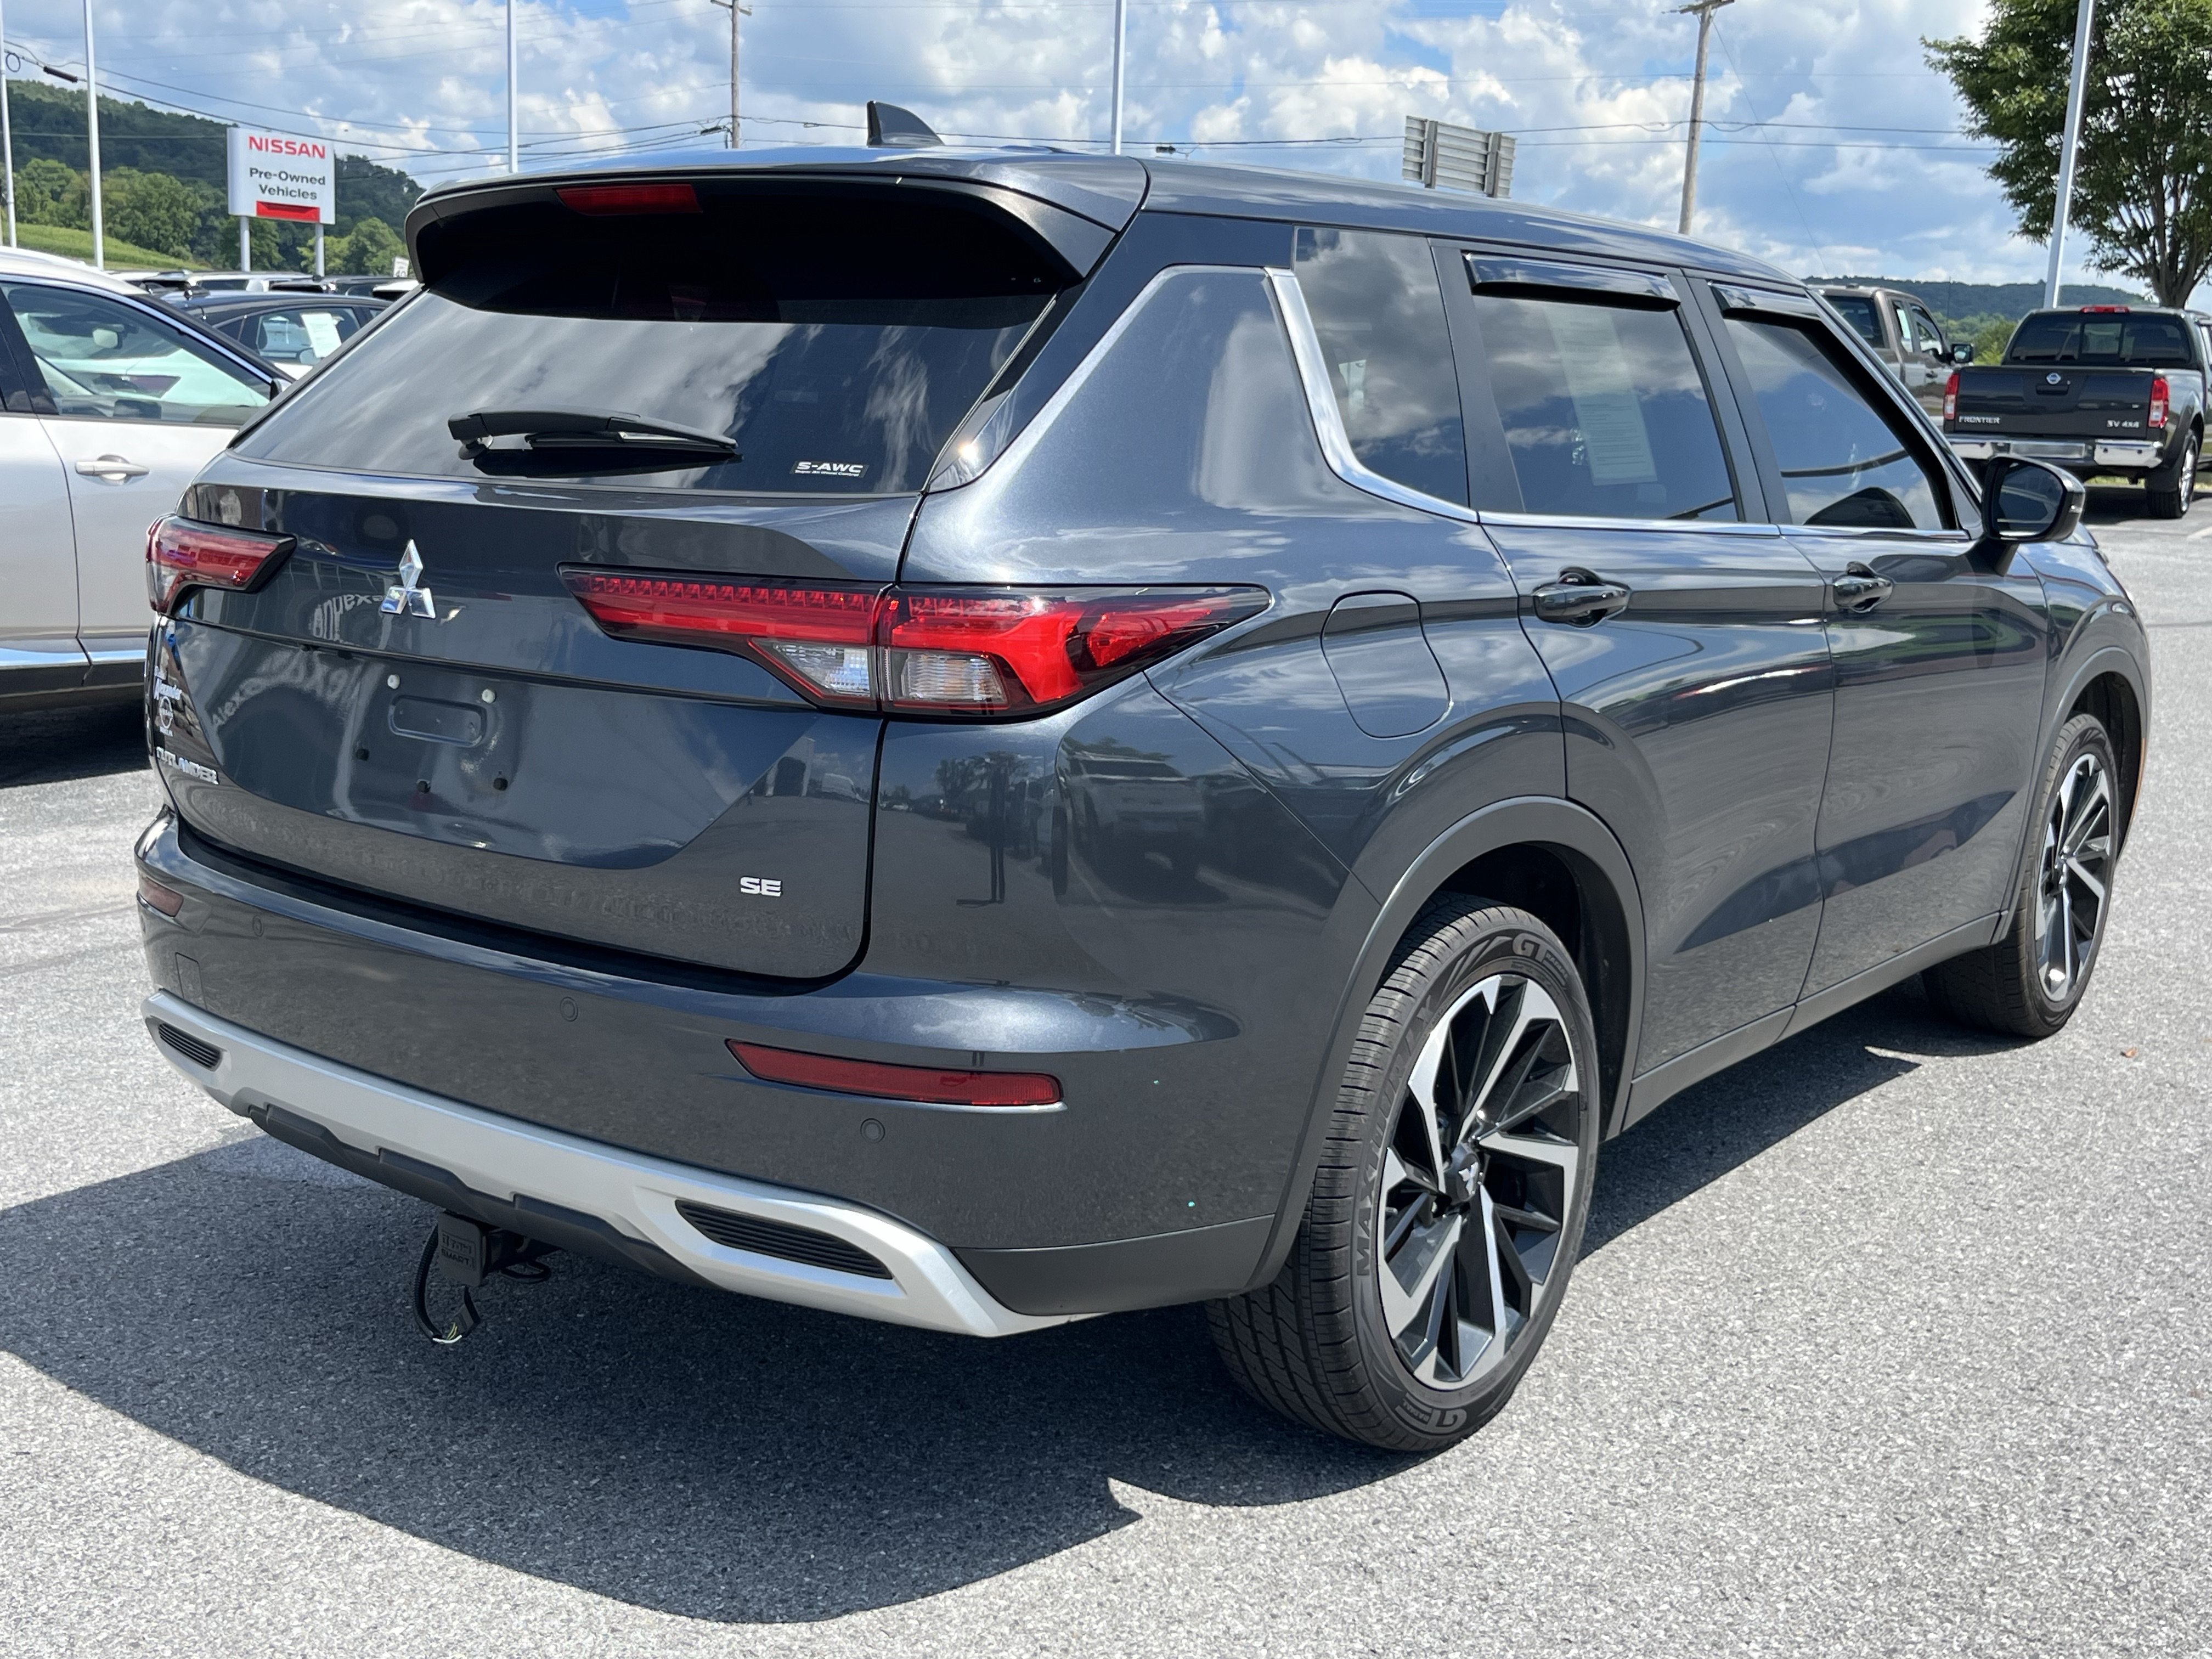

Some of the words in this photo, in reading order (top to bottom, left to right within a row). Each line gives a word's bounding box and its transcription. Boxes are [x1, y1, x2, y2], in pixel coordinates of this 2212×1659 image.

[249, 136, 326, 159] NISSAN
[249, 167, 326, 185] Pre-Owned
[258, 184, 318, 200] Vehicles
[1959, 415, 2000, 424] FRONTIER
[797, 461, 864, 473] S-AWC
[740, 877, 782, 897] SE
[1512, 932, 1550, 963] GT
